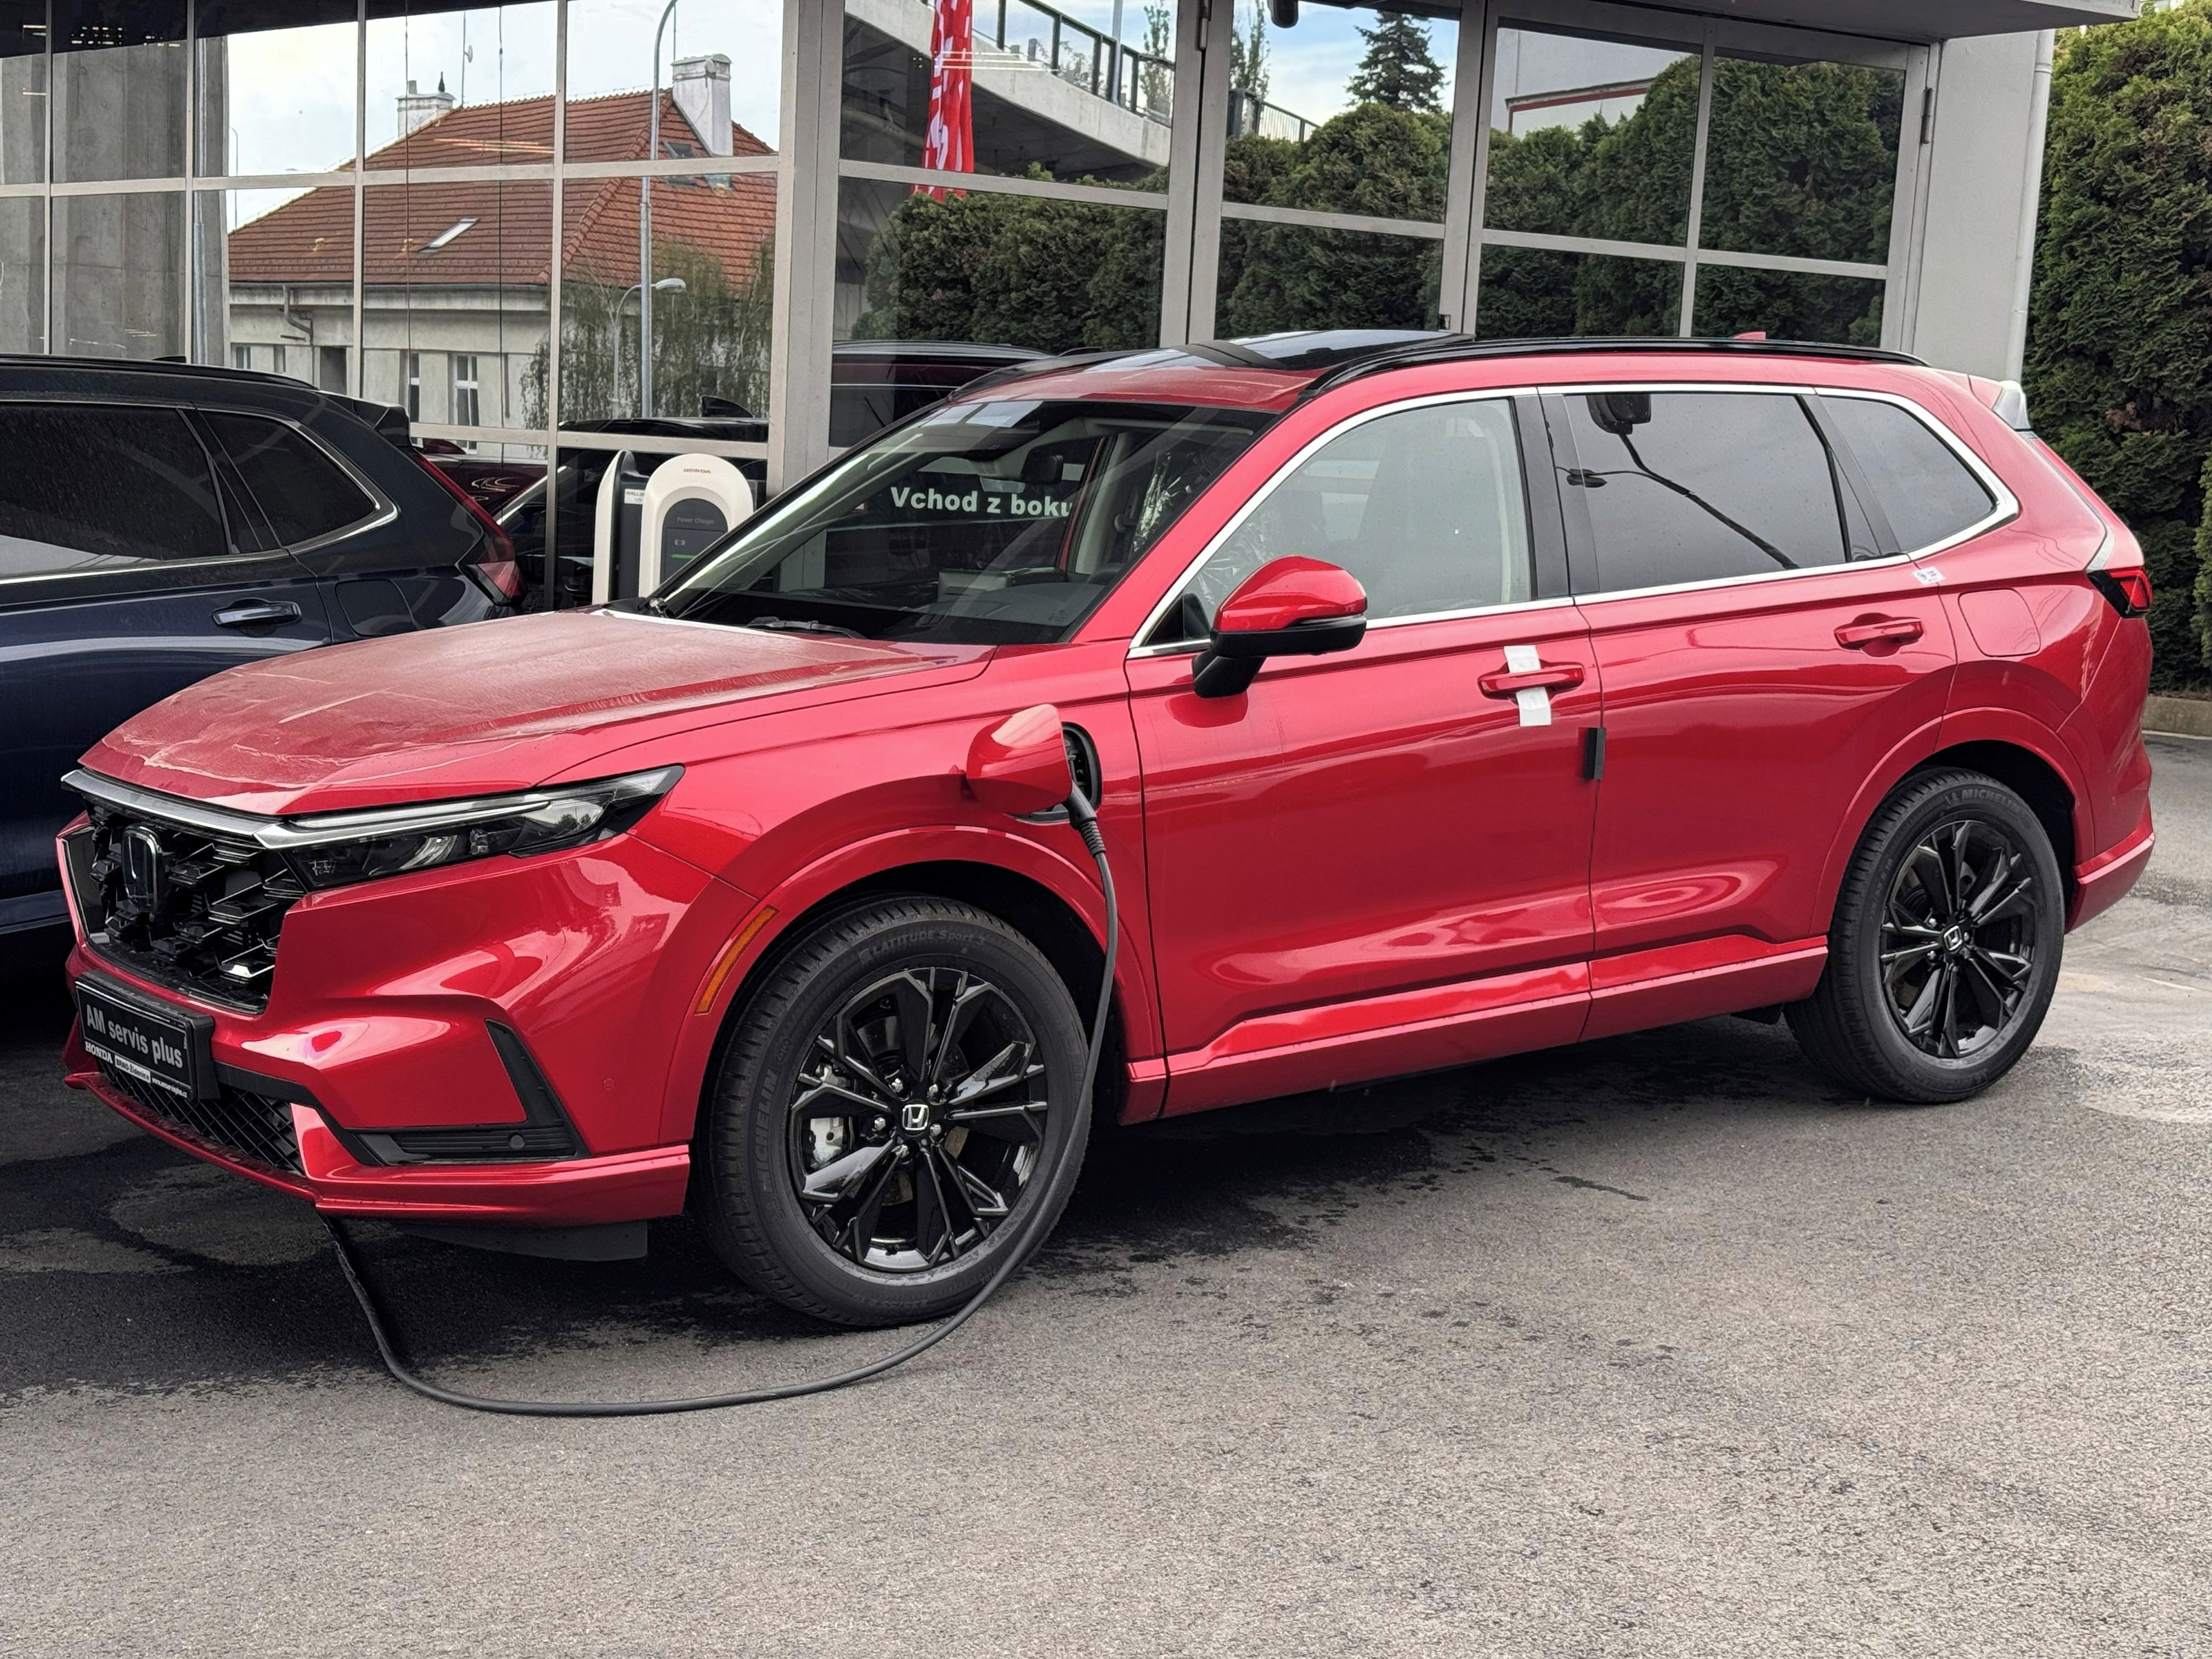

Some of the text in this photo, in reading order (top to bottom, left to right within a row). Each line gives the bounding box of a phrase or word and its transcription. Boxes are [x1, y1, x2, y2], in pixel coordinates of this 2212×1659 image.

[890, 487, 1073, 517] Vchod z boku
[872, 929, 986, 955] LATITUDE Sport 3
[86, 1004, 183, 1069] AM servis plus
[84, 1041, 114, 1064] HONDA
[754, 1068, 778, 1193] MICHELIN
